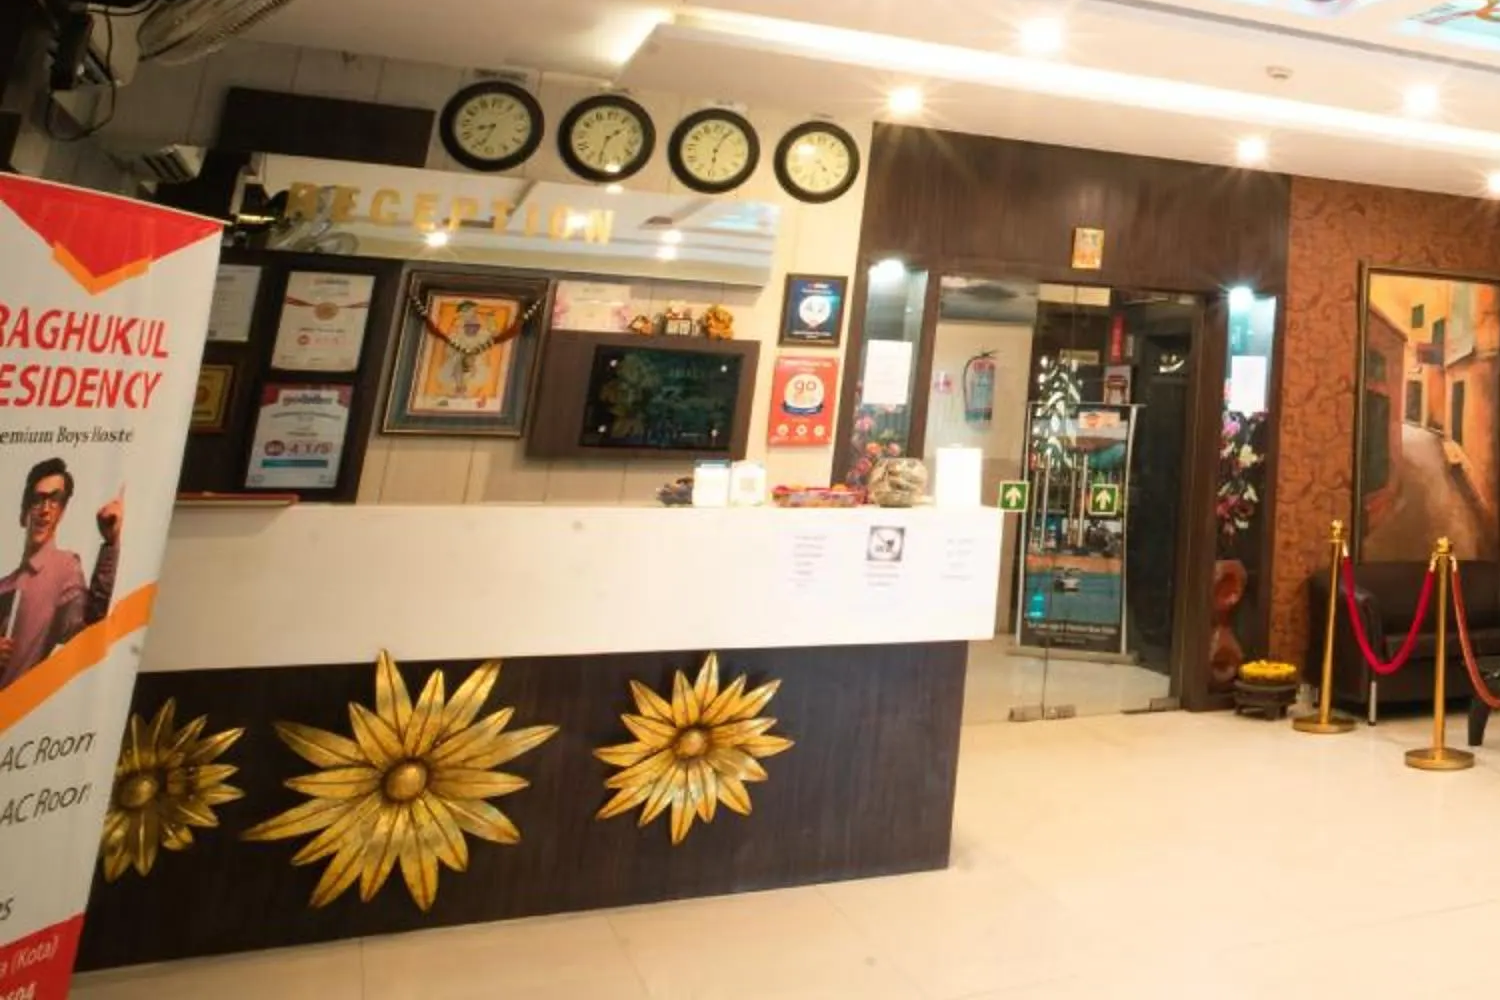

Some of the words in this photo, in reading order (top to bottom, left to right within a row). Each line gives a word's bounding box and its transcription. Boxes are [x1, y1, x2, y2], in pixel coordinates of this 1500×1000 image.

[286, 181, 616, 245] RECEPTION
[0, 363, 162, 410] ESIDENCY
[0, 426, 54, 444] emium
[57, 425, 89, 448] Boys
[90, 425, 134, 443] Hoste
[0, 739, 35, 773] AC
[0, 792, 35, 826] AC
